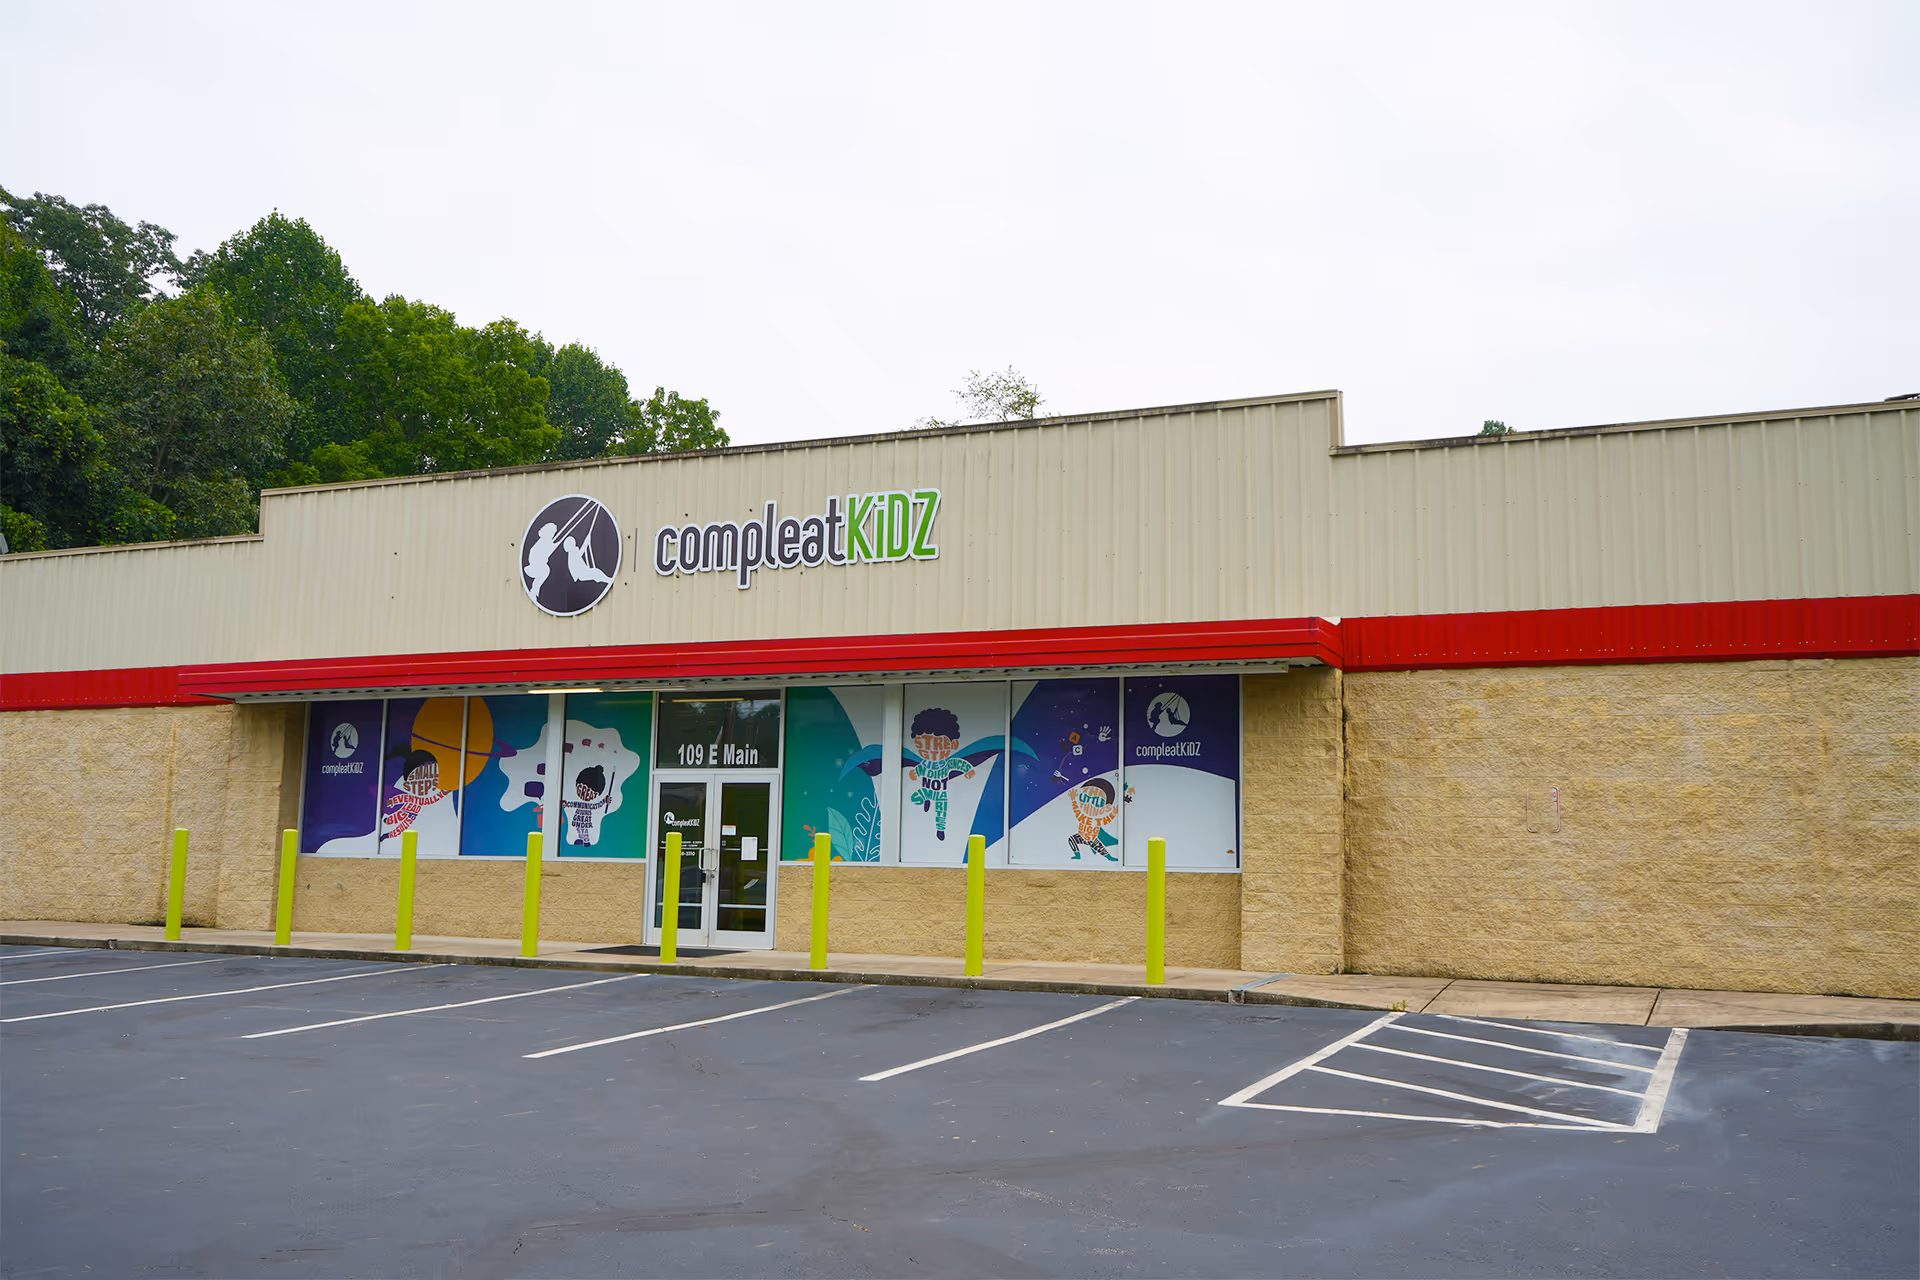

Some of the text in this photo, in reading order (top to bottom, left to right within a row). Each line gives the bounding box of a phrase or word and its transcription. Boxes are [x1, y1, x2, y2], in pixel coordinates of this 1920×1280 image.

[654, 488, 941, 589] compleatKiDZ
[678, 743, 759, 765] 109 E Main
[1136, 742, 1201, 760] compleatKiDZ
[408, 763, 439, 781] SMALL
[915, 764, 926, 777] IN
[922, 760, 946, 770] LIES
[403, 779, 439, 796] STEPS
[922, 777, 948, 791] NOT
[393, 791, 445, 806] EVENTUALLY
[1079, 793, 1105, 808] LITTLE
[401, 803, 421, 814] LEAD
[1072, 801, 1115, 827] MAKE THE
[387, 810, 408, 825] BIG
[389, 818, 413, 838] RESULTS
